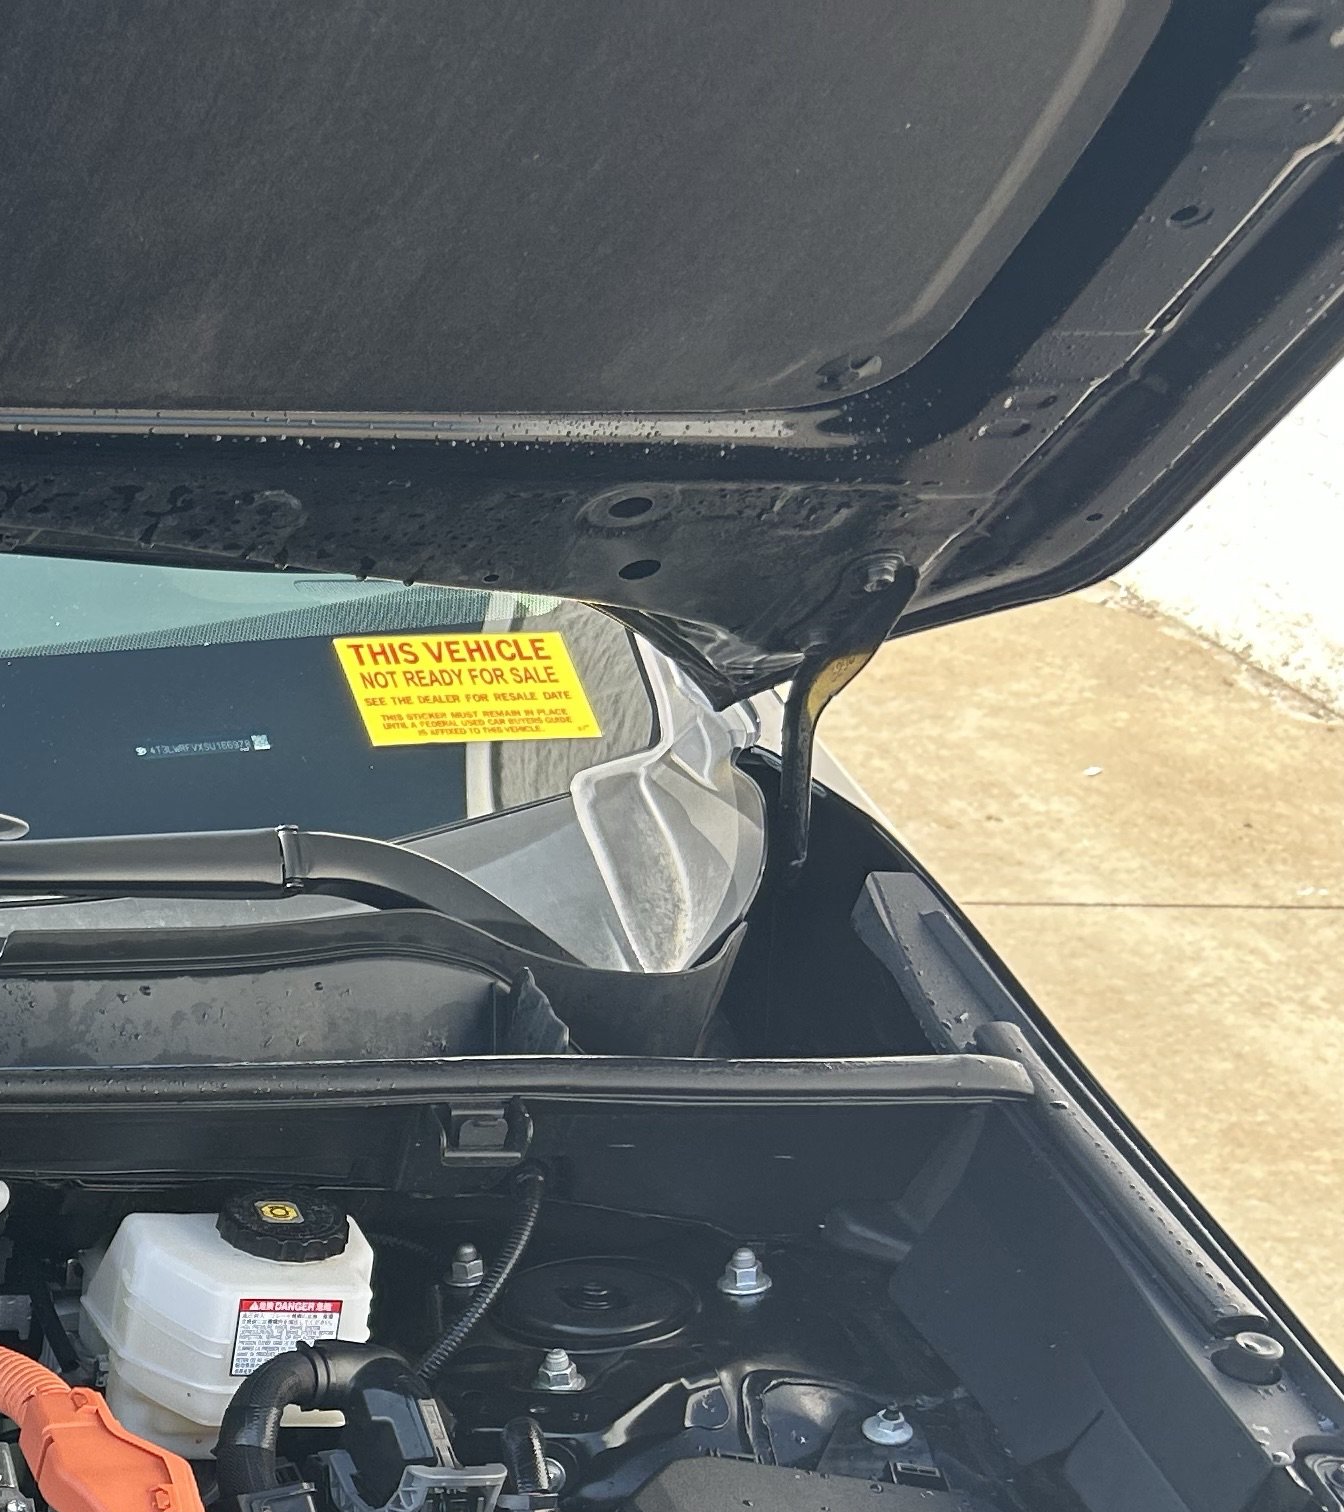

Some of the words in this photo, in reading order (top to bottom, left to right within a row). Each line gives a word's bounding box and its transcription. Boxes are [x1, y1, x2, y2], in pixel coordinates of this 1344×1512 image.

[347, 642, 419, 666] THIS
[422, 638, 552, 663] VEHICLE
[359, 671, 399, 689] NOT
[405, 669, 464, 688] READY
[468, 667, 508, 686] FOR
[511, 666, 559, 684] SALE
[364, 697, 388, 706] SEE
[391, 696, 414, 706] THE
[419, 694, 461, 704] DEALER
[465, 693, 488, 703] FOR
[494, 691, 538, 702] RESALE
[543, 690, 572, 700] DATE
[274, 1301, 315, 1311] DANGER
